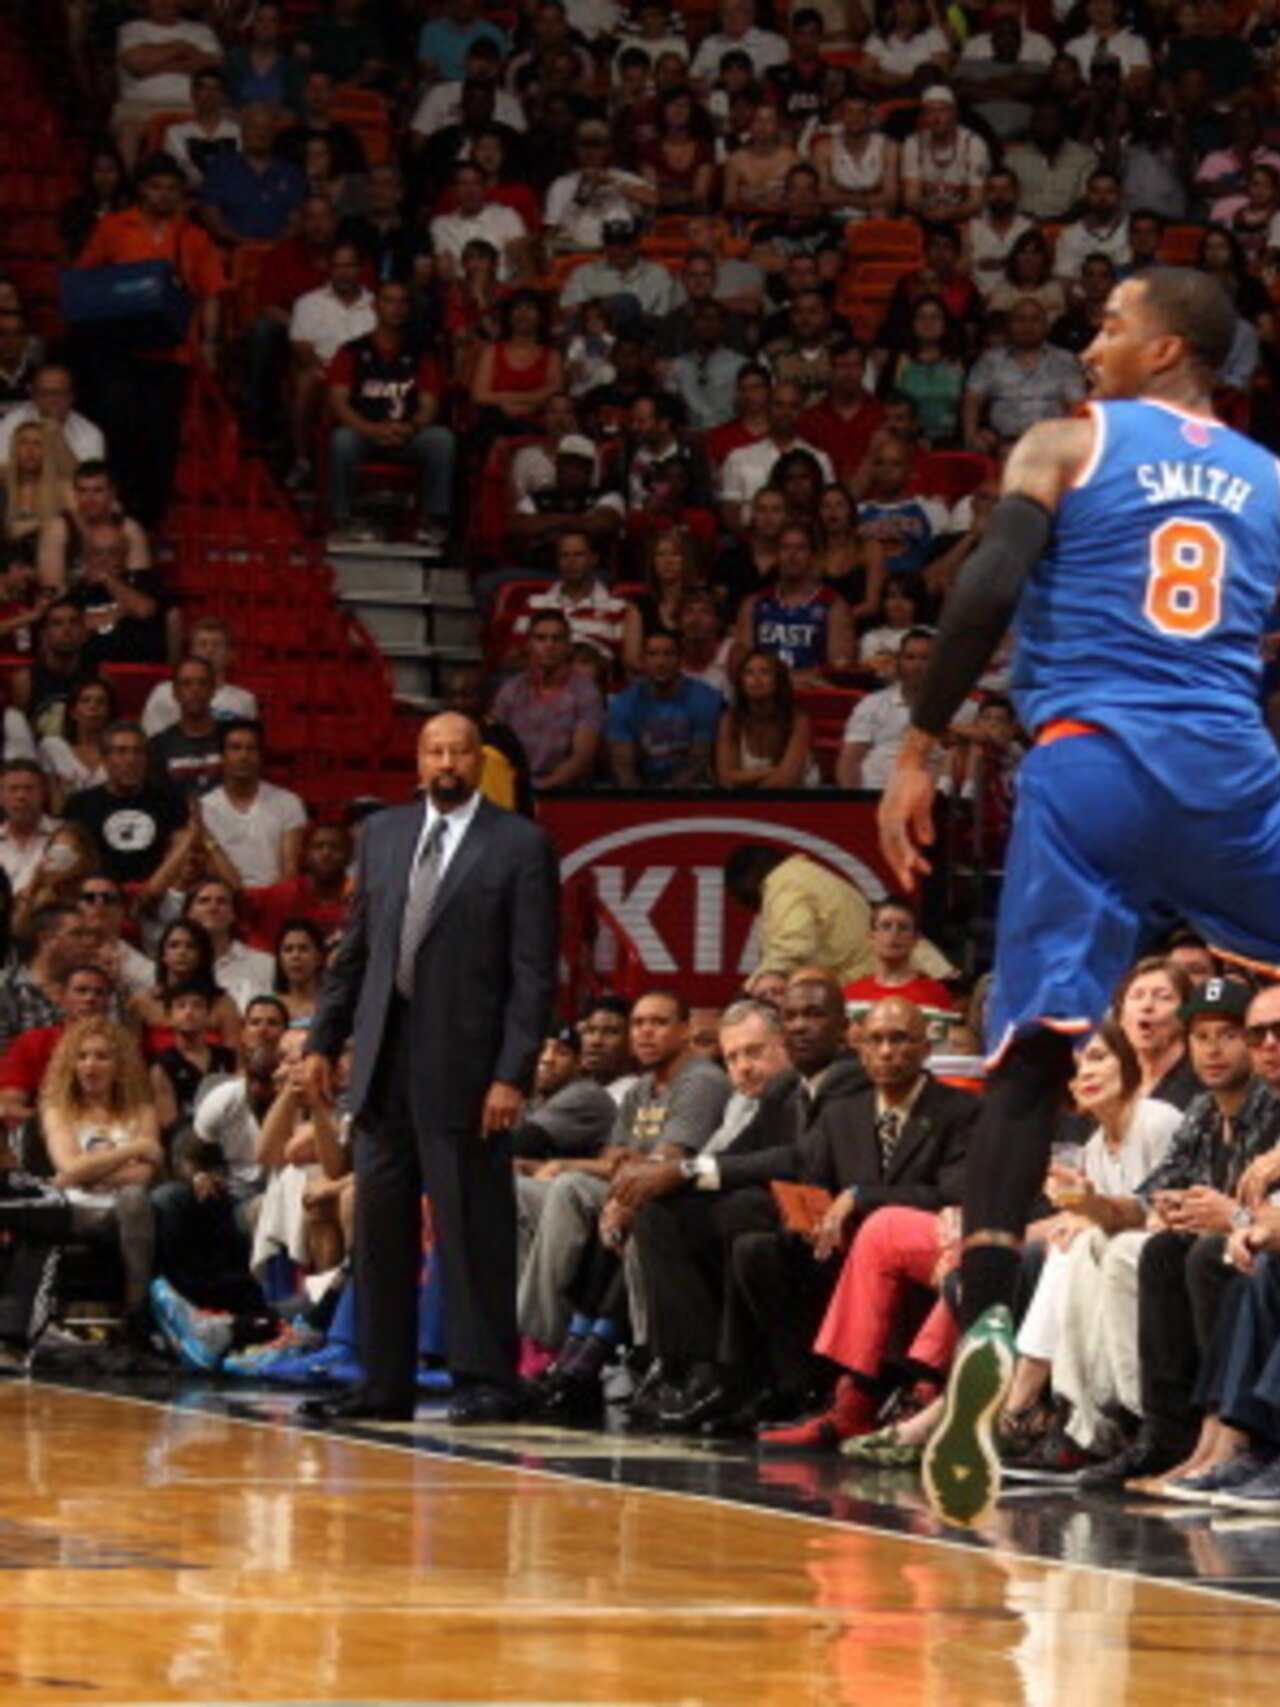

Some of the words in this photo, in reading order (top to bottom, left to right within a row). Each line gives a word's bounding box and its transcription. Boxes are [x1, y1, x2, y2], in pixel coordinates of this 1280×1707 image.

[1137, 460, 1252, 514] SMITH
[1143, 517, 1225, 638] 8
[758, 623, 816, 647] EAST
